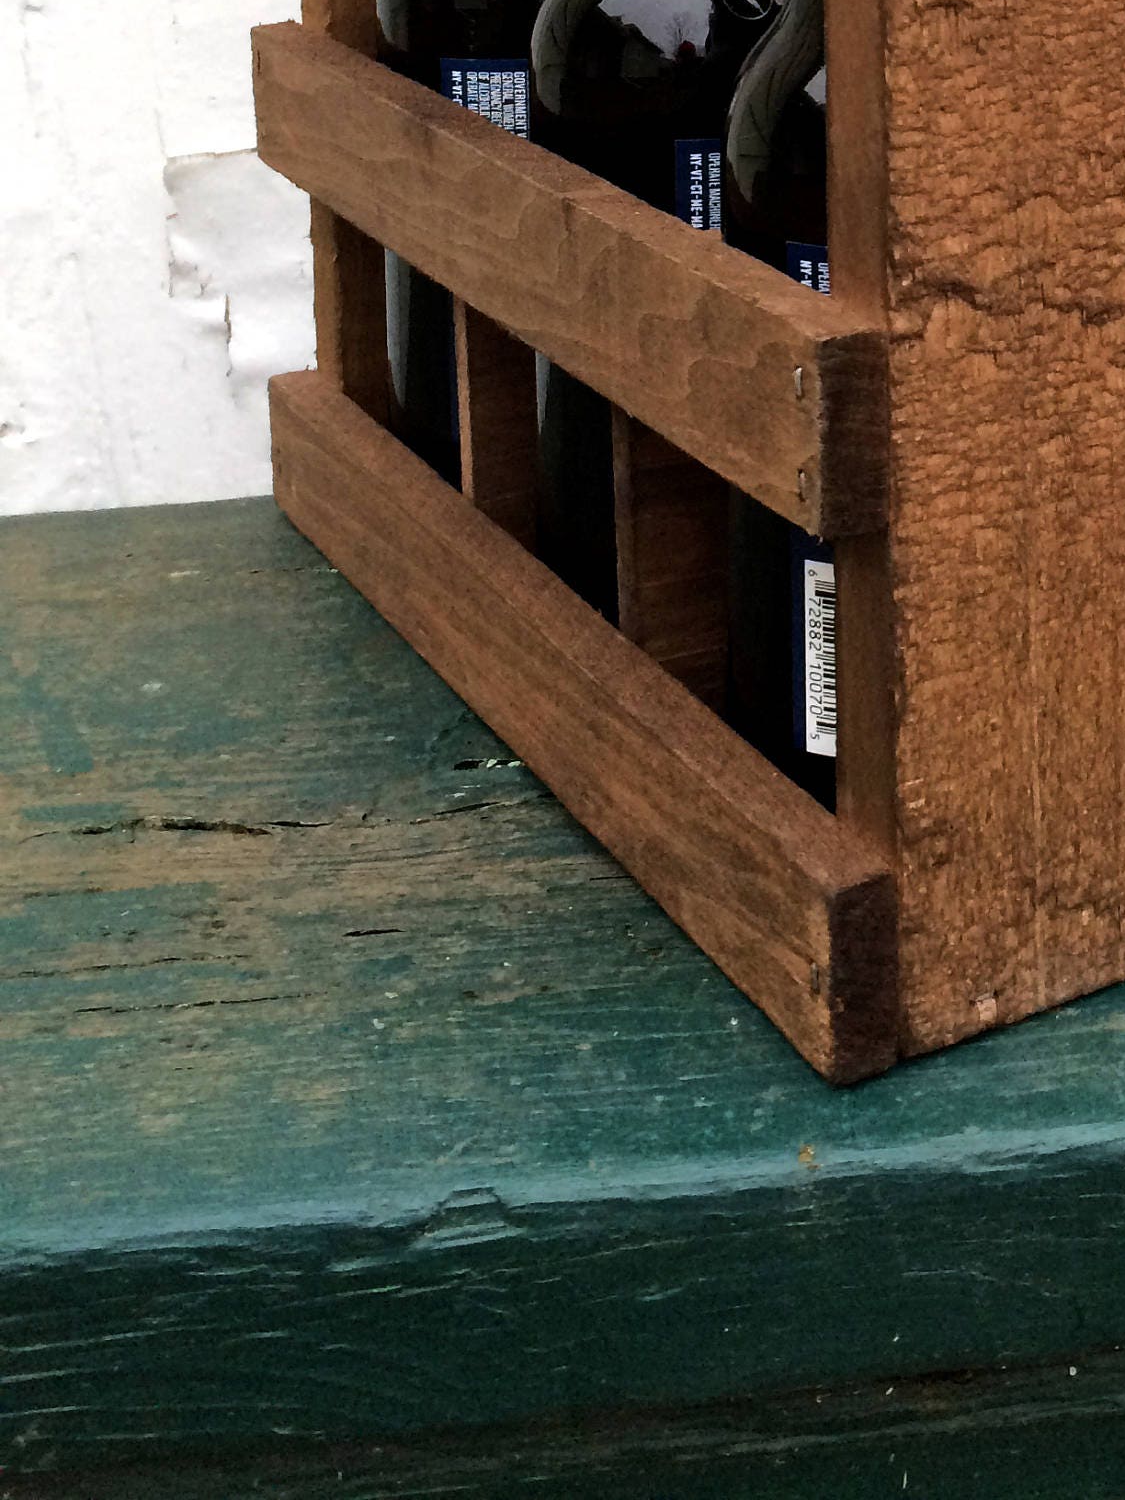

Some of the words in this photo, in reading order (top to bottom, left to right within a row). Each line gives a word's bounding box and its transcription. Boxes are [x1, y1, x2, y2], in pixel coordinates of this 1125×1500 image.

[513, 71, 527, 130] GOVERNMENT
[807, 568, 817, 577] 6
[808, 596, 822, 652] 72882
[809, 664, 823, 716] 10070
